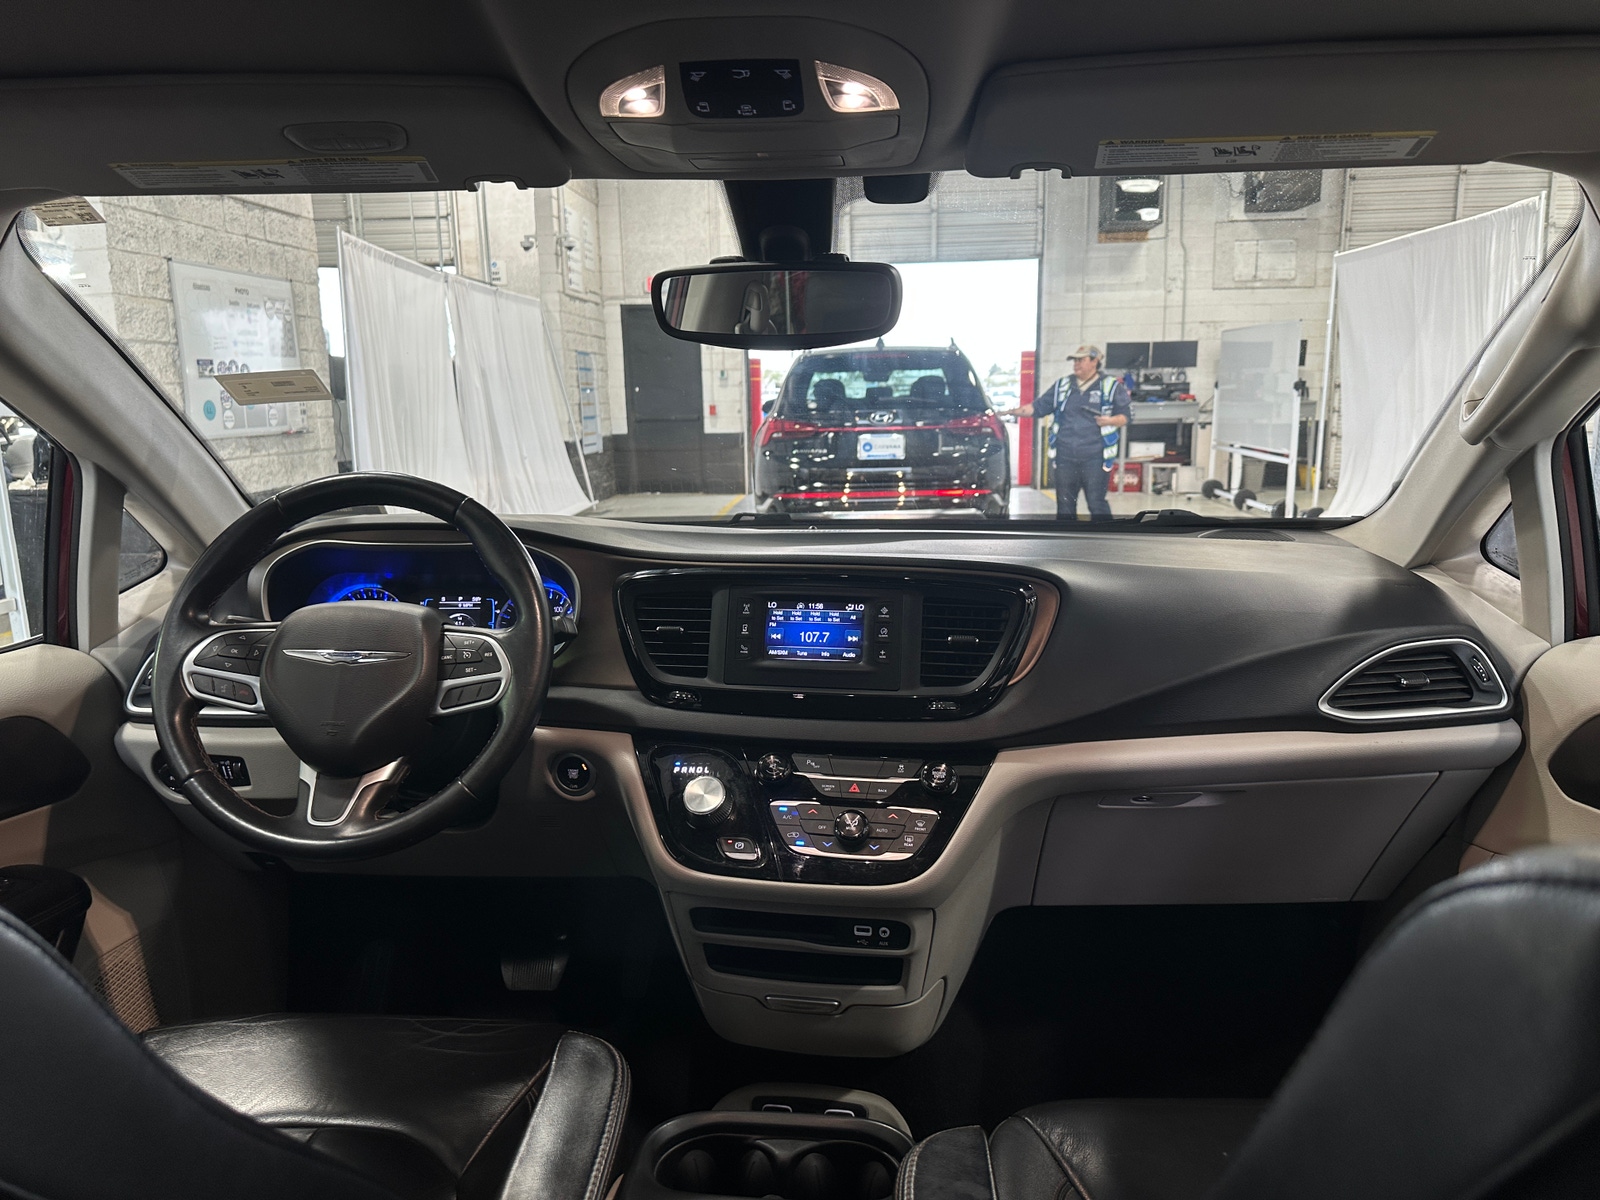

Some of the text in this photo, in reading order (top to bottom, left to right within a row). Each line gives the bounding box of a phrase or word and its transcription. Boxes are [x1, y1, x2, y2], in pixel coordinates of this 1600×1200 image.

[767, 601, 777, 609] LO
[855, 603, 865, 611] LO
[799, 631, 830, 643] 107.7
